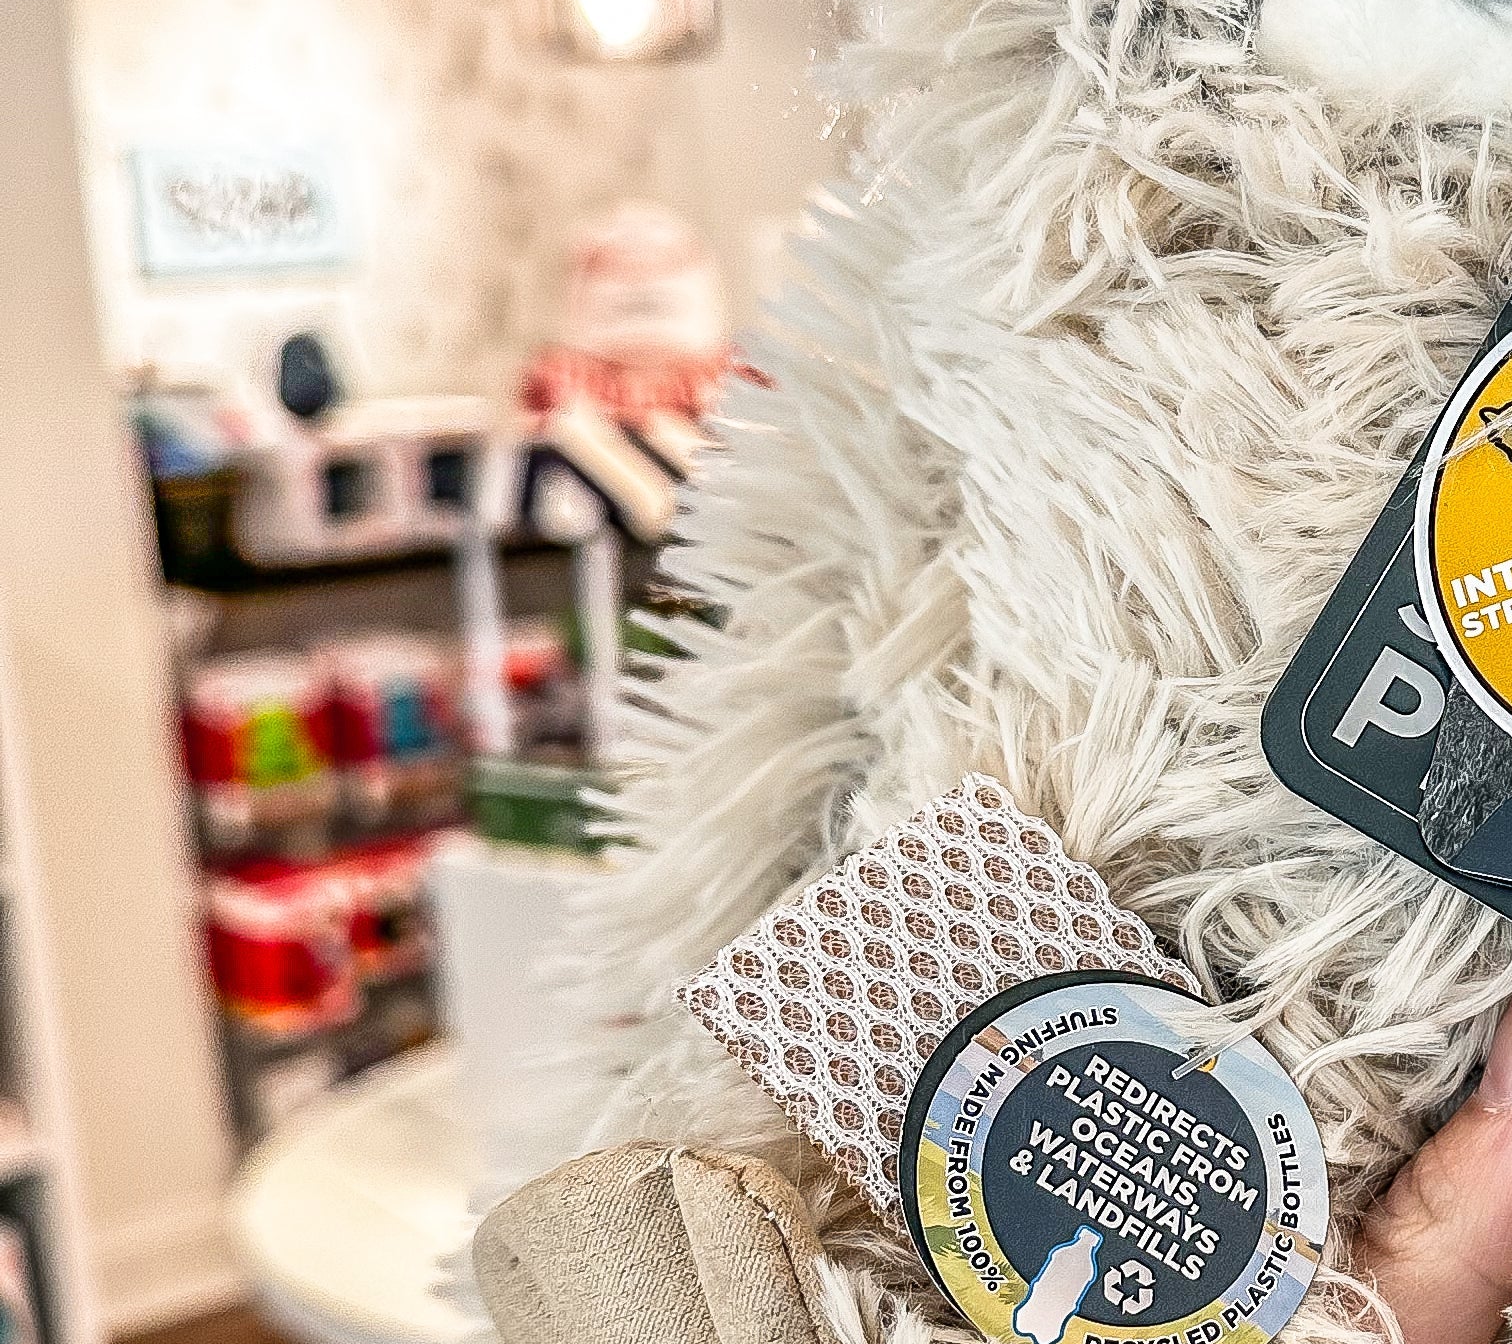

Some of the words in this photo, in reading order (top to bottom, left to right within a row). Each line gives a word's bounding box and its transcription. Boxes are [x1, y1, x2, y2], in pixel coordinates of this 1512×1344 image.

[1001, 1007, 1118, 1065] STUFFING
[953, 1062, 1005, 1135] MADE
[1046, 1065, 1170, 1154] PLASTIC
[1170, 1143, 1258, 1211] FROM
[1084, 1055, 1249, 1170] REDIRECTS
[948, 1140, 971, 1218] FROM
[1009, 1149, 1034, 1176] &
[1036, 1163, 1205, 1280] LANDFILLS
[1029, 1121, 1220, 1254] WATERWAYS
[1071, 1117, 1199, 1215] OCEANS,
[1267, 1113, 1300, 1229] BOTTLES
[957, 1224, 1005, 1291] 100%
[1222, 1233, 1293, 1329] PLASTIC
